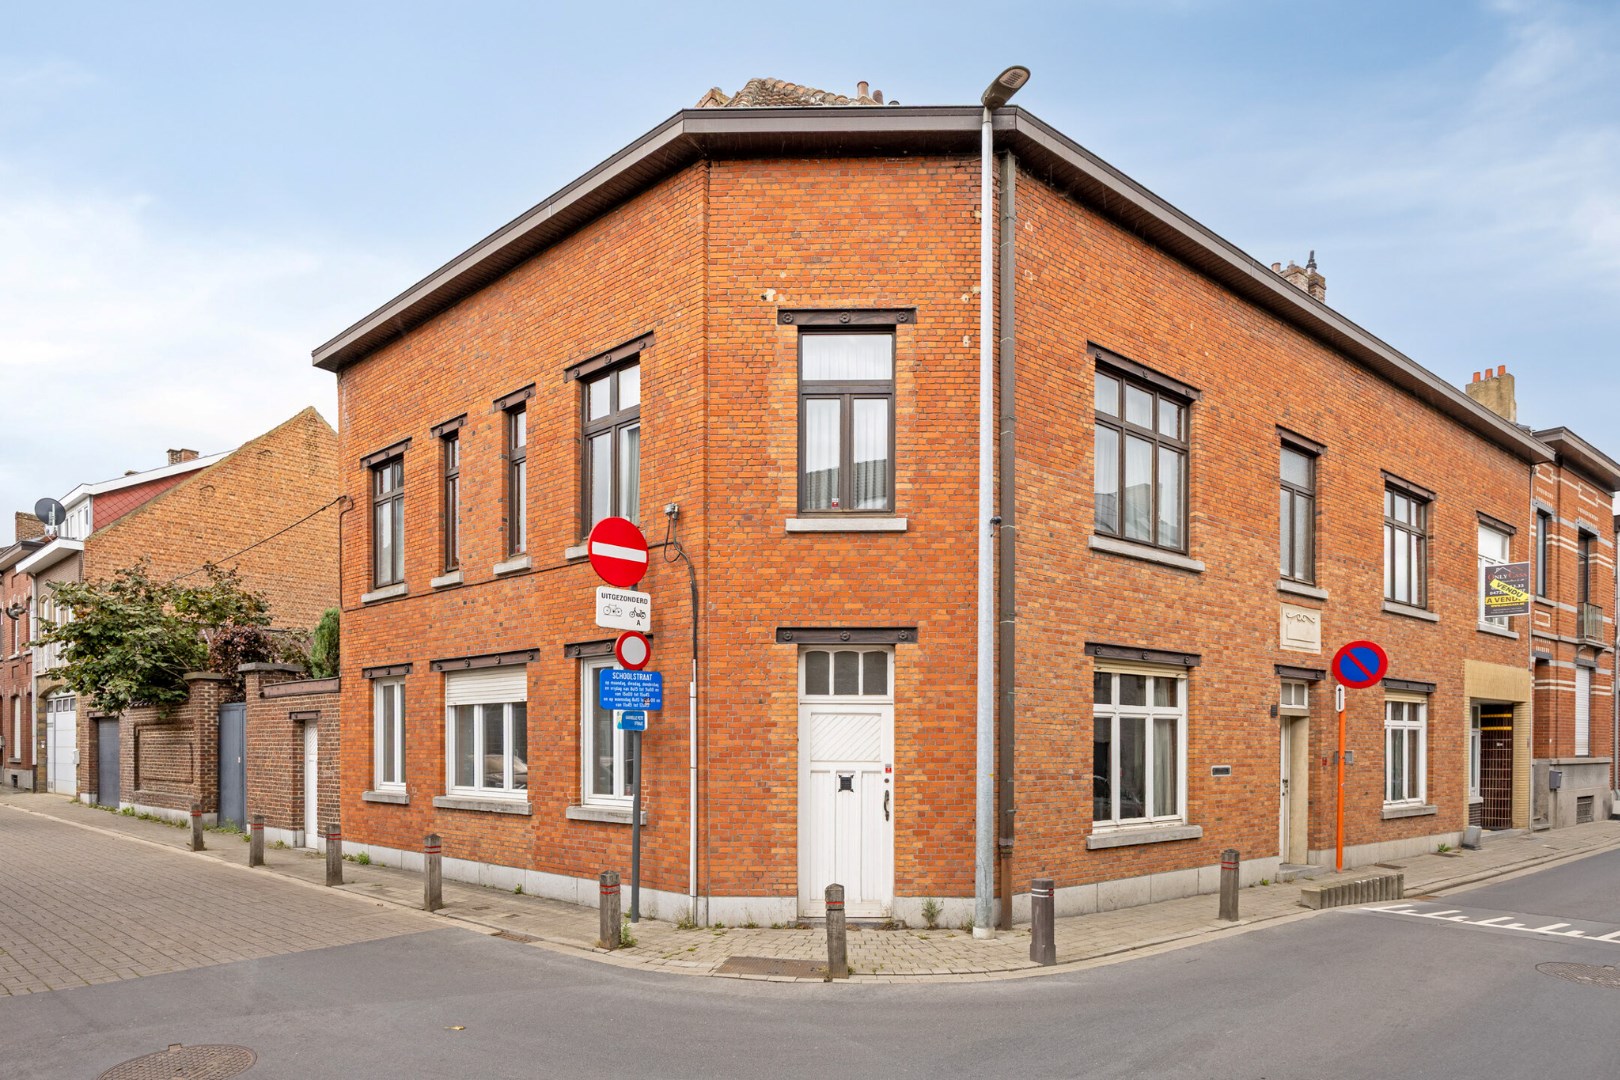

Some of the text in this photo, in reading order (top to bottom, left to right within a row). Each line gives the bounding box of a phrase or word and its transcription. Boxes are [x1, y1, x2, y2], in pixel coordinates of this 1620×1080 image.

[1496, 582, 1523, 598] VENDU
[601, 592, 648, 604] UITGEZONDERD
[612, 672, 652, 680] SCHOOLSTRAAT
